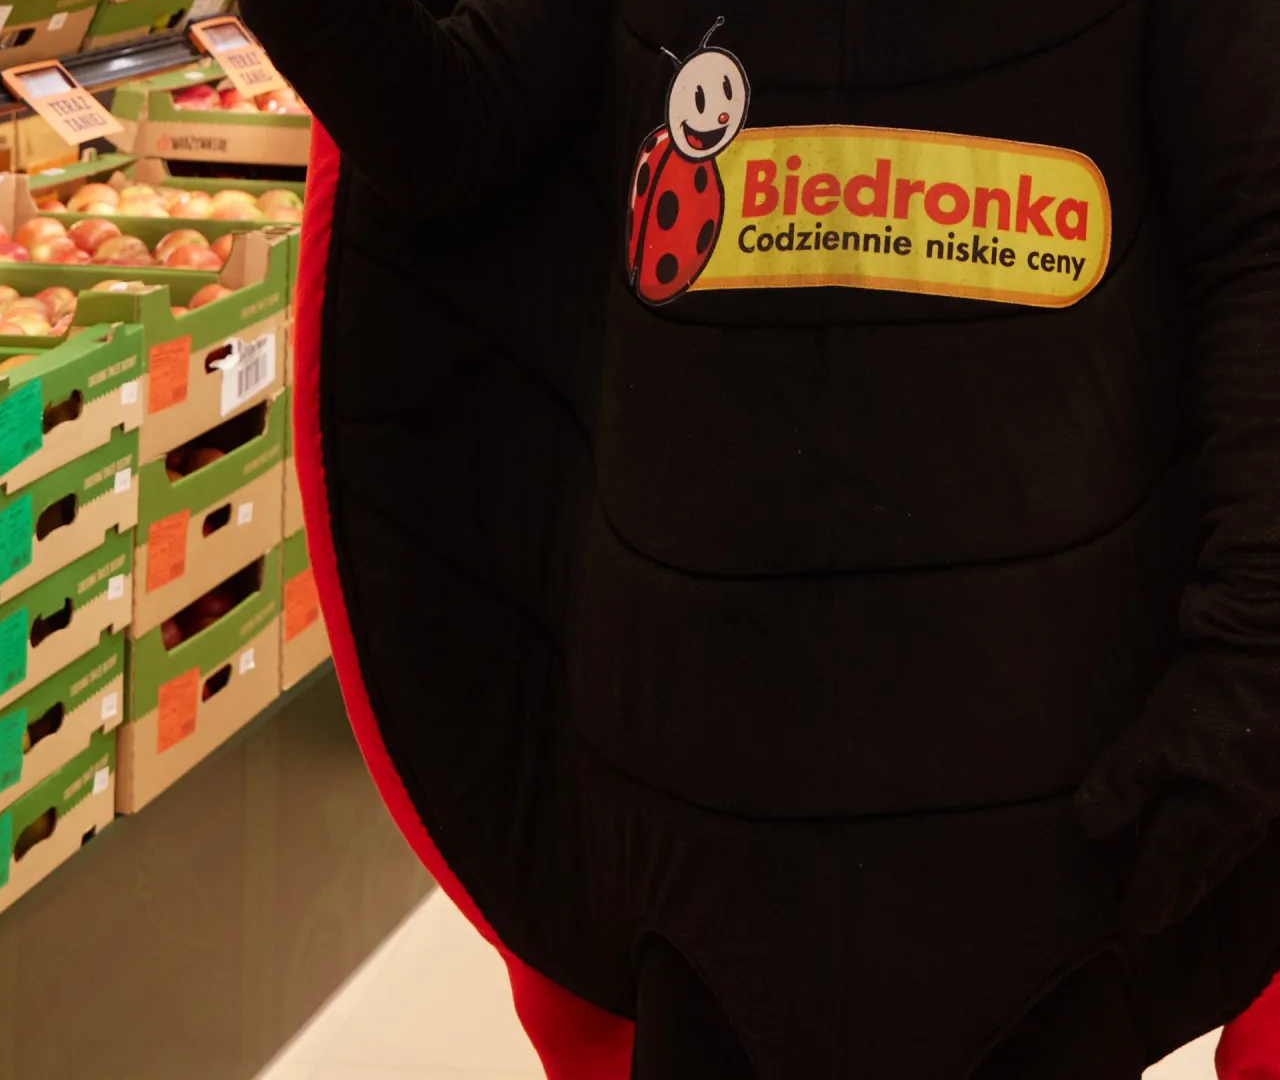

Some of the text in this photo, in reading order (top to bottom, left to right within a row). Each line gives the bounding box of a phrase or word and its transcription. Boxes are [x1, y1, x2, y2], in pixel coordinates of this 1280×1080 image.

[48, 94, 93, 117] TERAZ
[63, 110, 108, 133] TANIEJ
[740, 154, 1090, 242] Biedronka
[737, 224, 1087, 282] Codziennie niskie ceny
